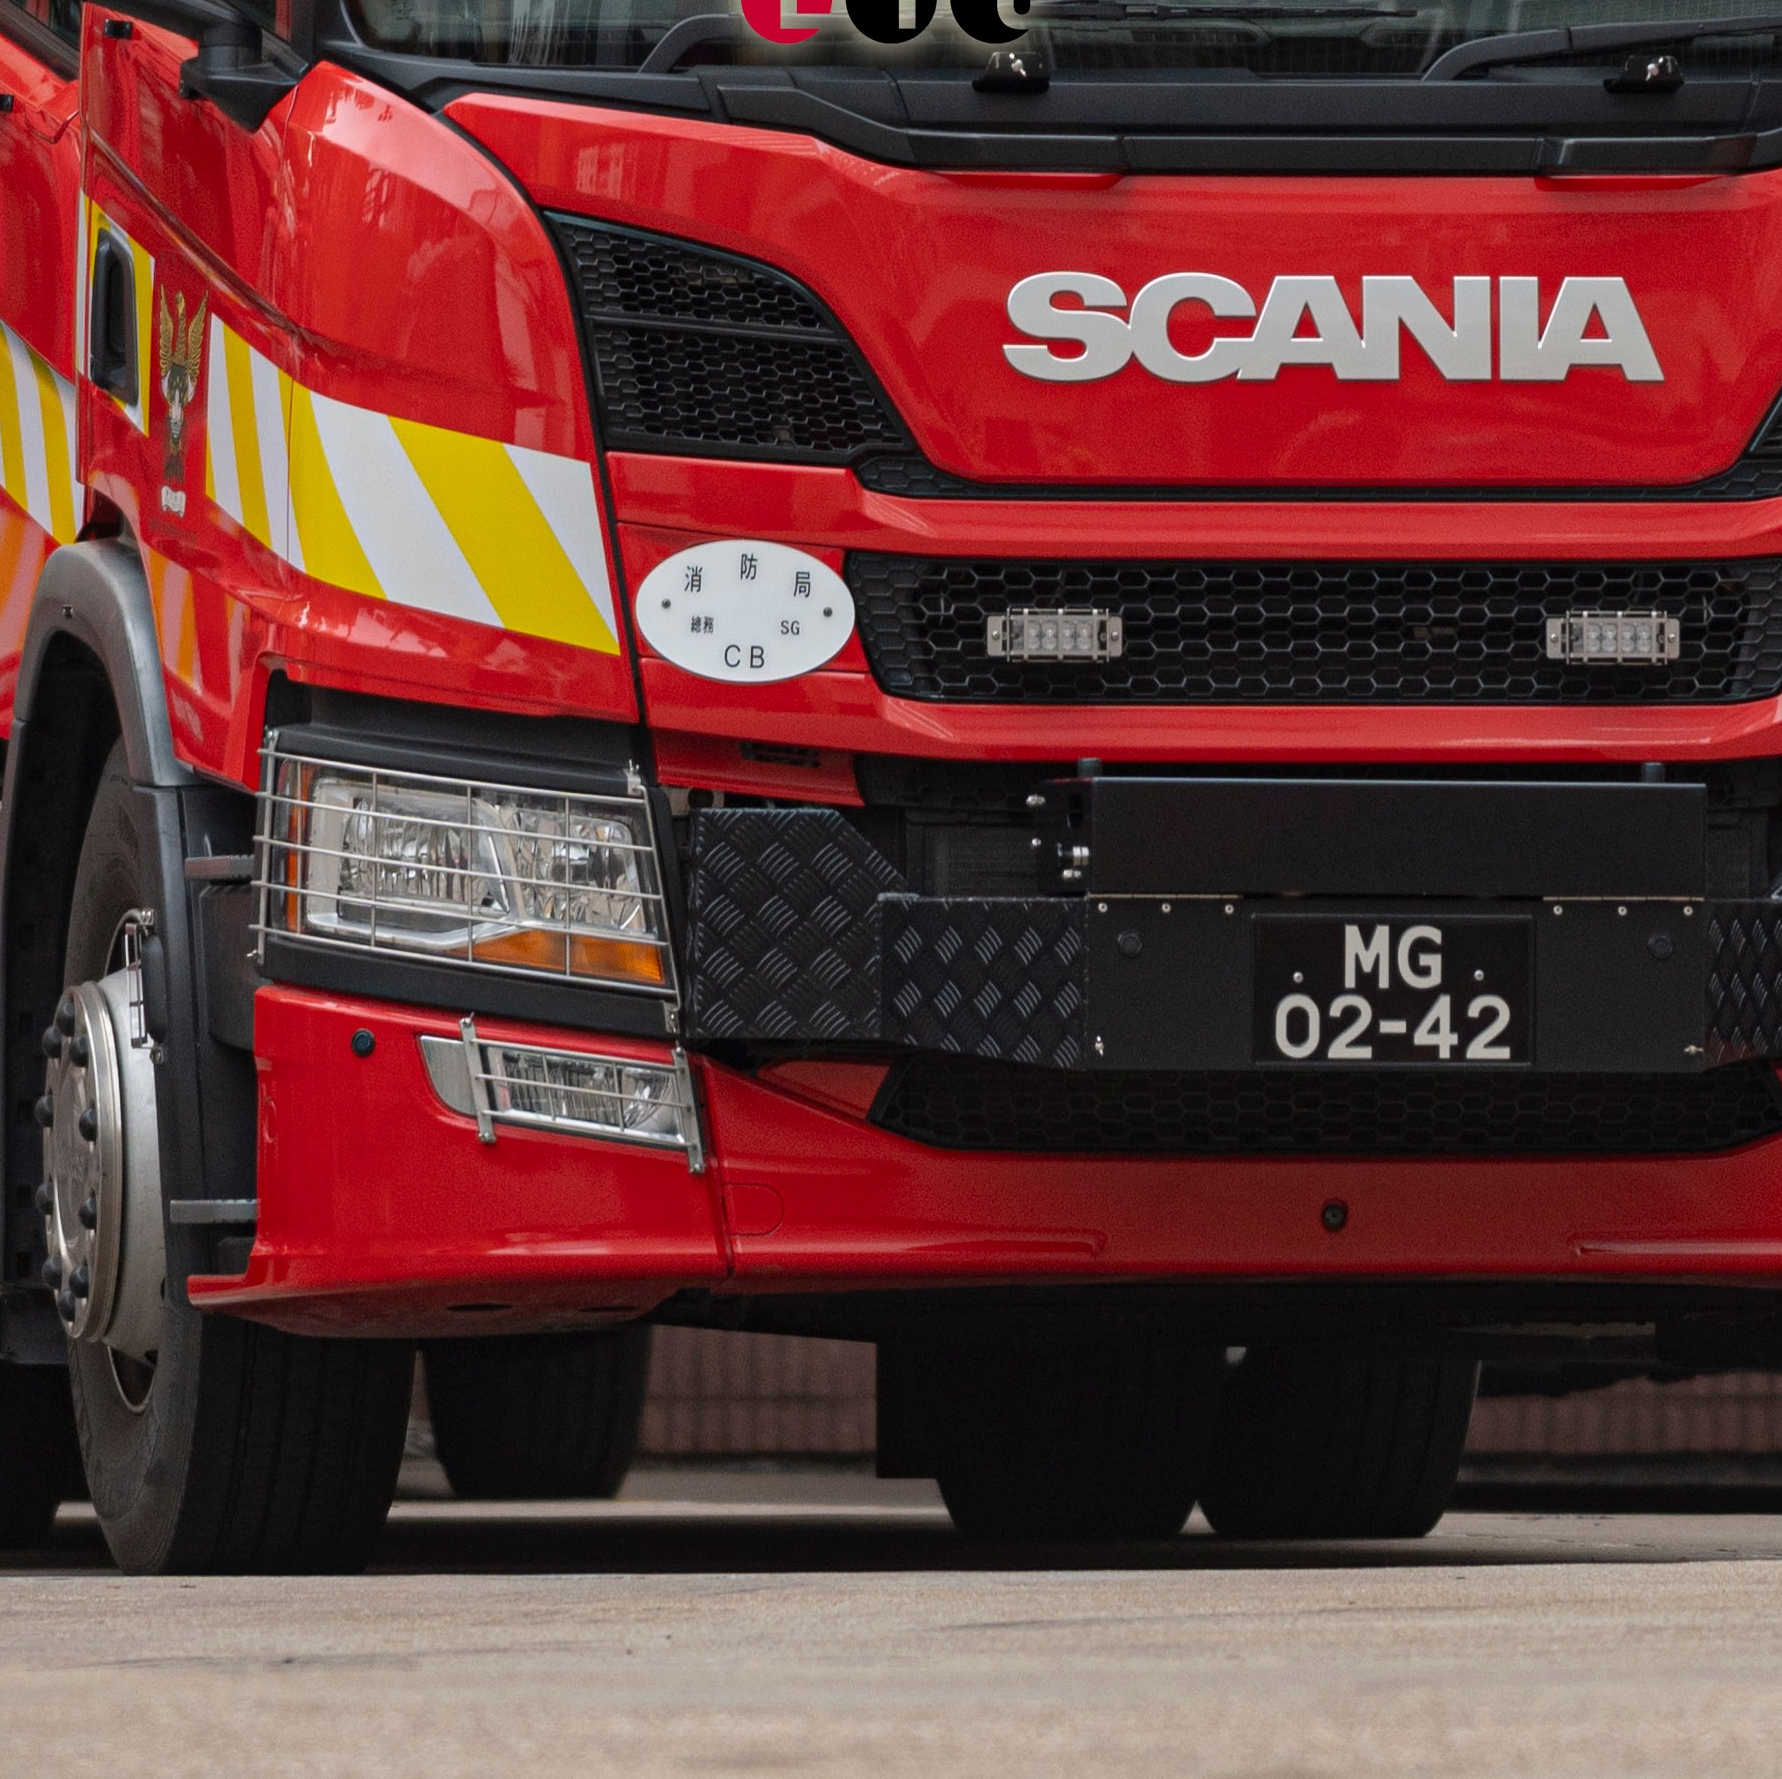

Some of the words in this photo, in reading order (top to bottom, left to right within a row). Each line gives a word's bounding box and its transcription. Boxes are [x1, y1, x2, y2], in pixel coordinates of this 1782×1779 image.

[1002, 271, 1665, 383] SCANIA
[780, 621, 800, 635] SG
[1344, 924, 1442, 989] MG
[1275, 993, 1511, 1060] 02-42
